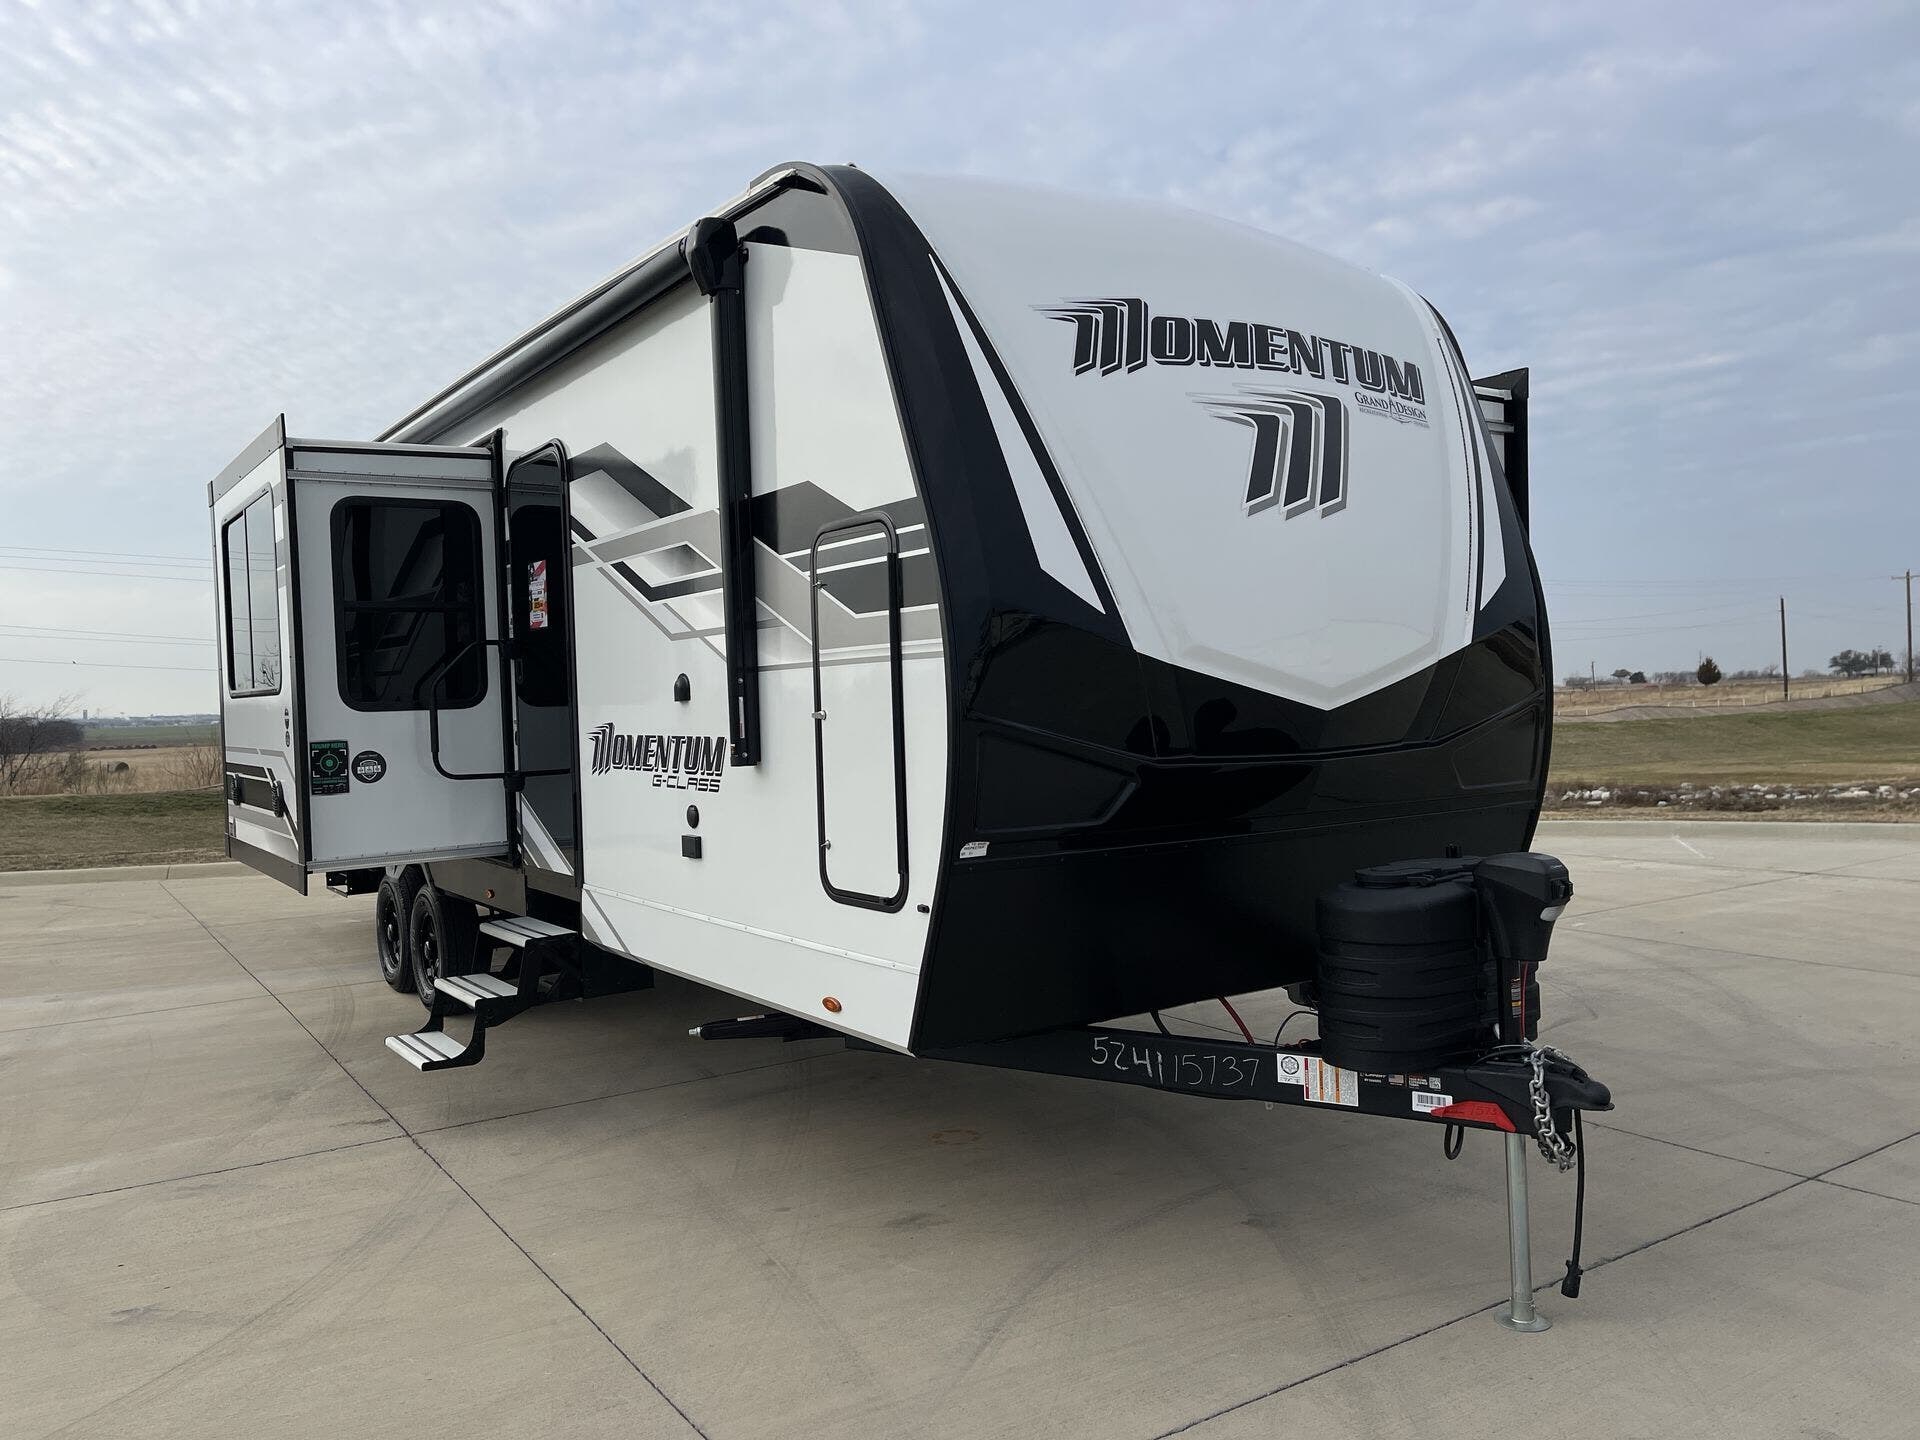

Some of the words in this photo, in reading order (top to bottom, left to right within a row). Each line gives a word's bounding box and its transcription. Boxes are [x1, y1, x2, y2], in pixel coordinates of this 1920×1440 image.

[1032, 296, 1426, 405] MOMENTUM
[1355, 391, 1389, 410] GRAND
[1396, 401, 1427, 420] DESIGN
[586, 722, 727, 777] MOMENTUM
[652, 774, 721, 793] G-CLASS
